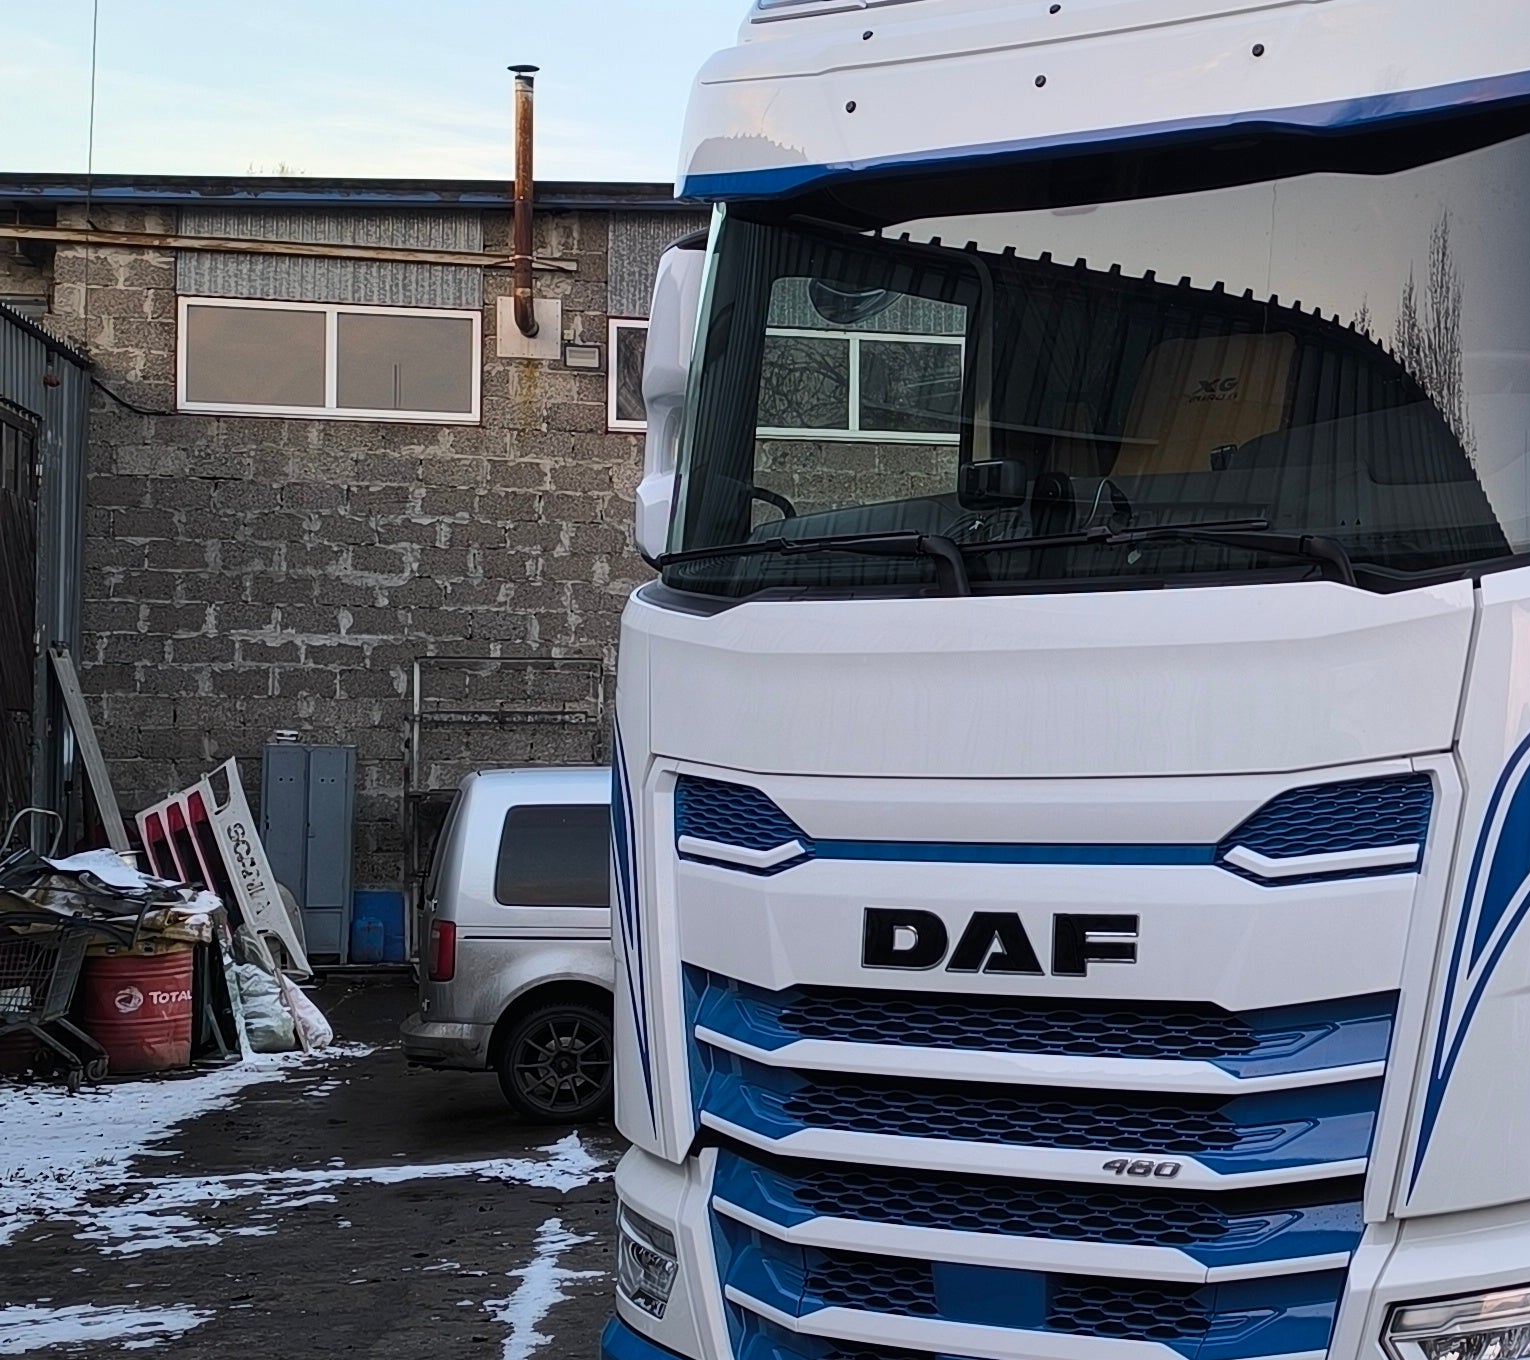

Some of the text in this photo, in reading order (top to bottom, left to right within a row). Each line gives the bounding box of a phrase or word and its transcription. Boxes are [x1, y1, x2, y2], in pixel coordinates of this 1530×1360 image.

[861, 906, 1140, 977] DAF
[148, 990, 192, 1005] TOTAL
[1102, 1158, 1182, 1179] 480
